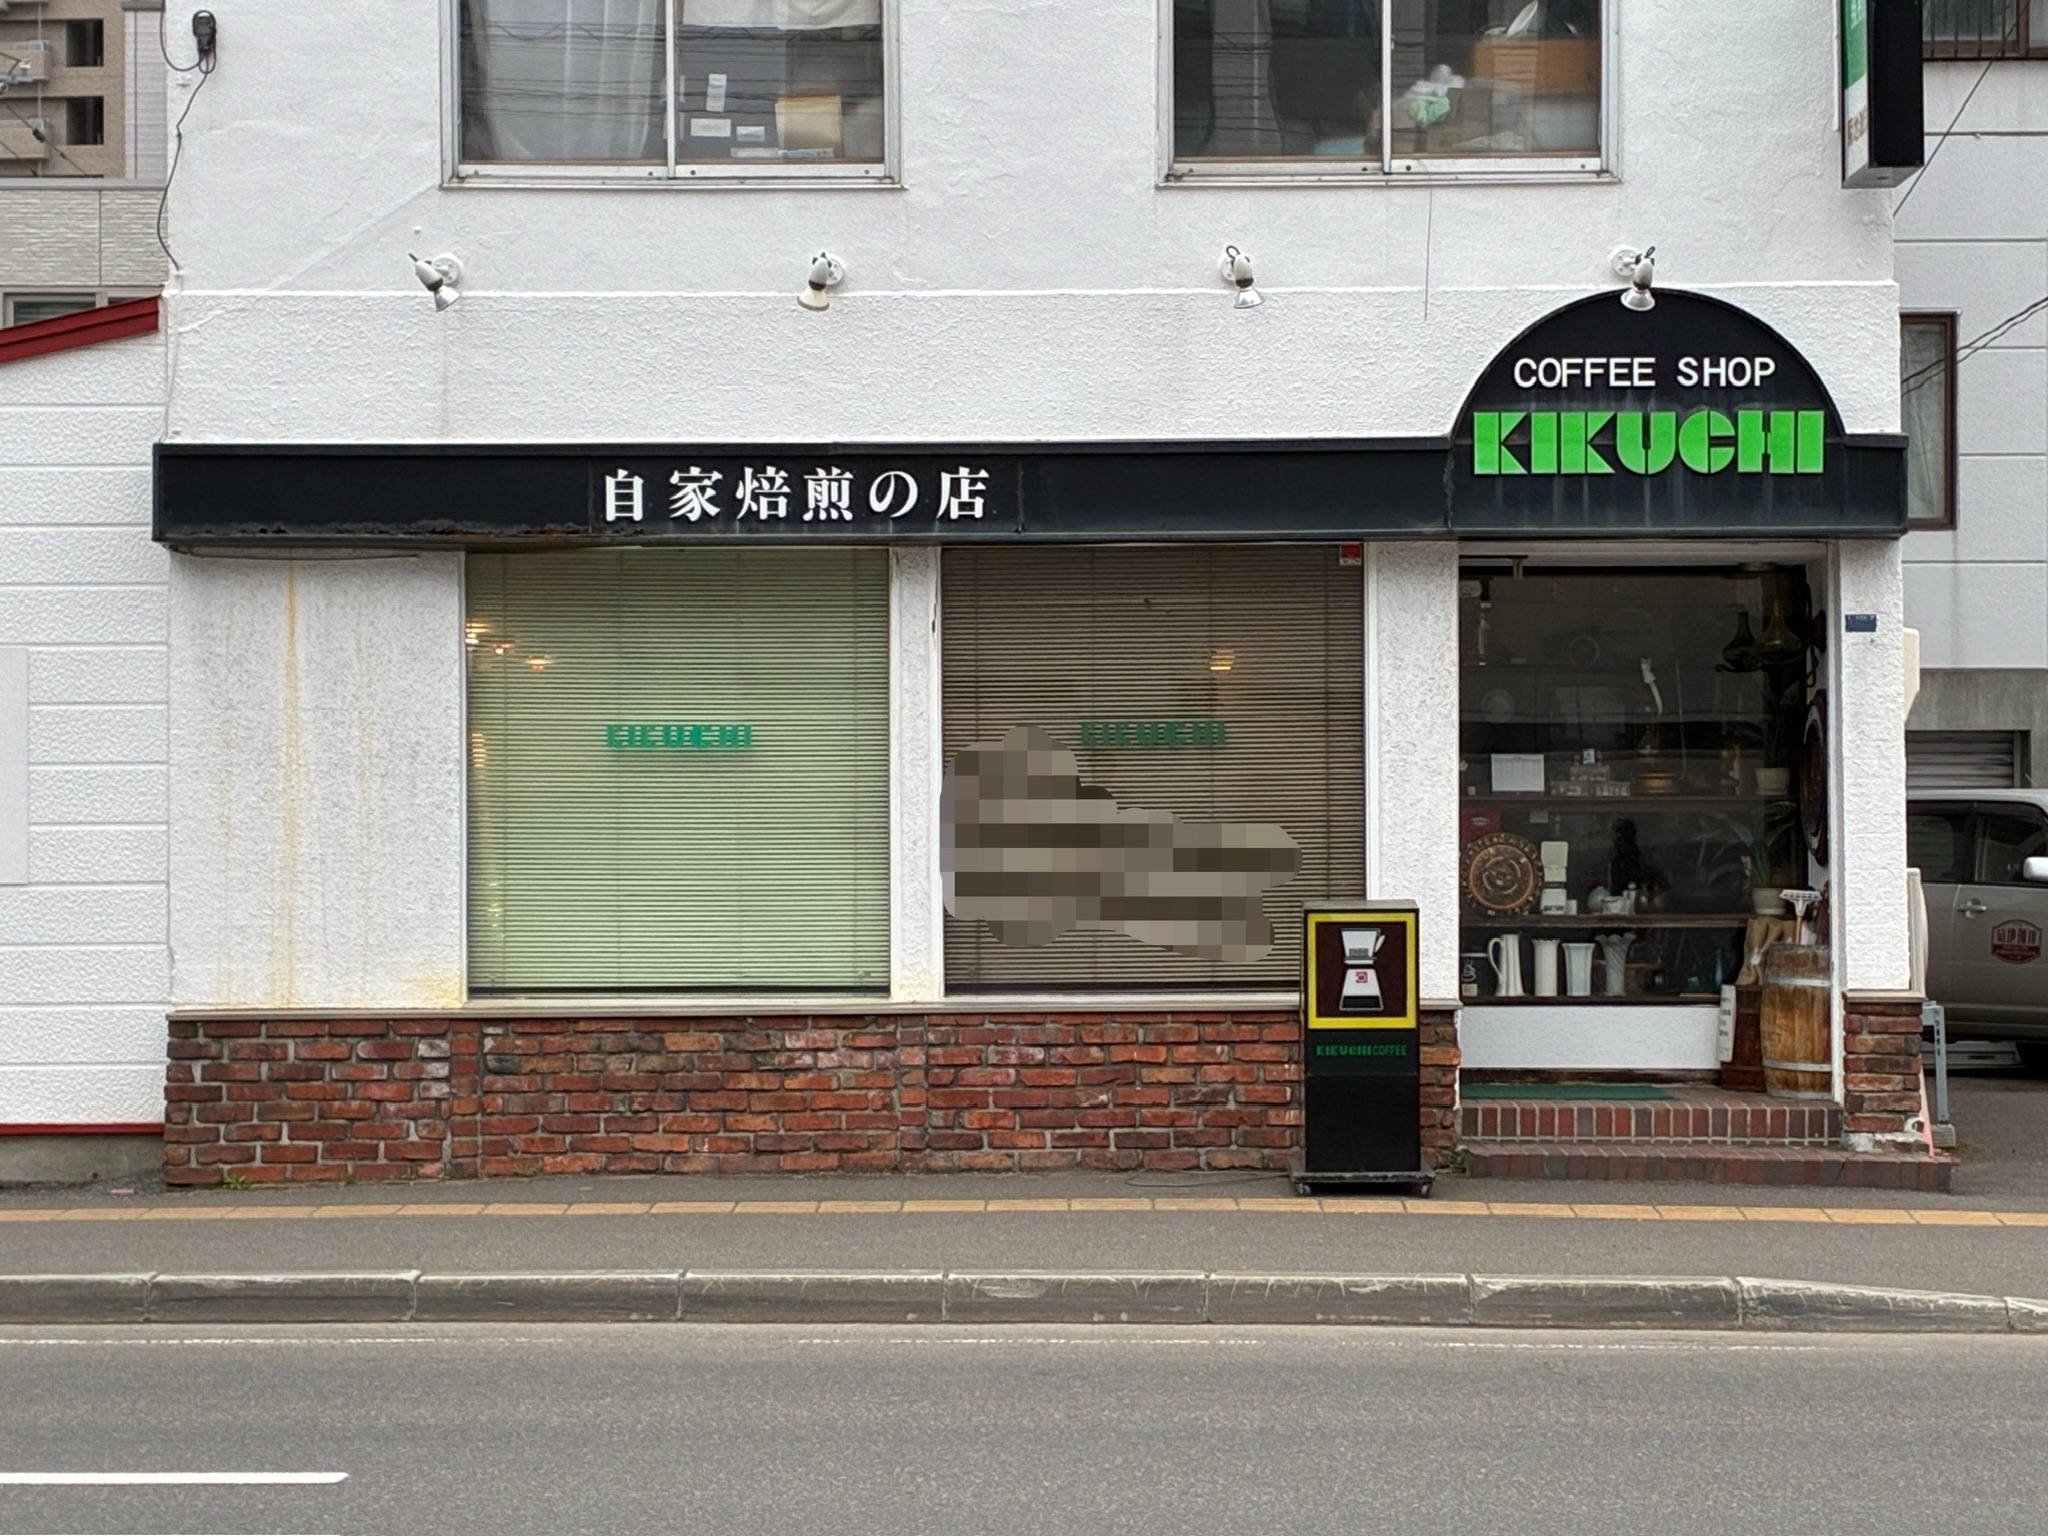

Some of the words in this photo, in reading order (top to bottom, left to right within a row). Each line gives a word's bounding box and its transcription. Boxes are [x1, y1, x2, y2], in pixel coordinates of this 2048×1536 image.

[1513, 357, 1656, 388] COFFEE
[1677, 357, 1776, 387] SHOP
[1473, 410, 1825, 475] KIKUCHI
[603, 466, 990, 523] 自家焙煎の店
